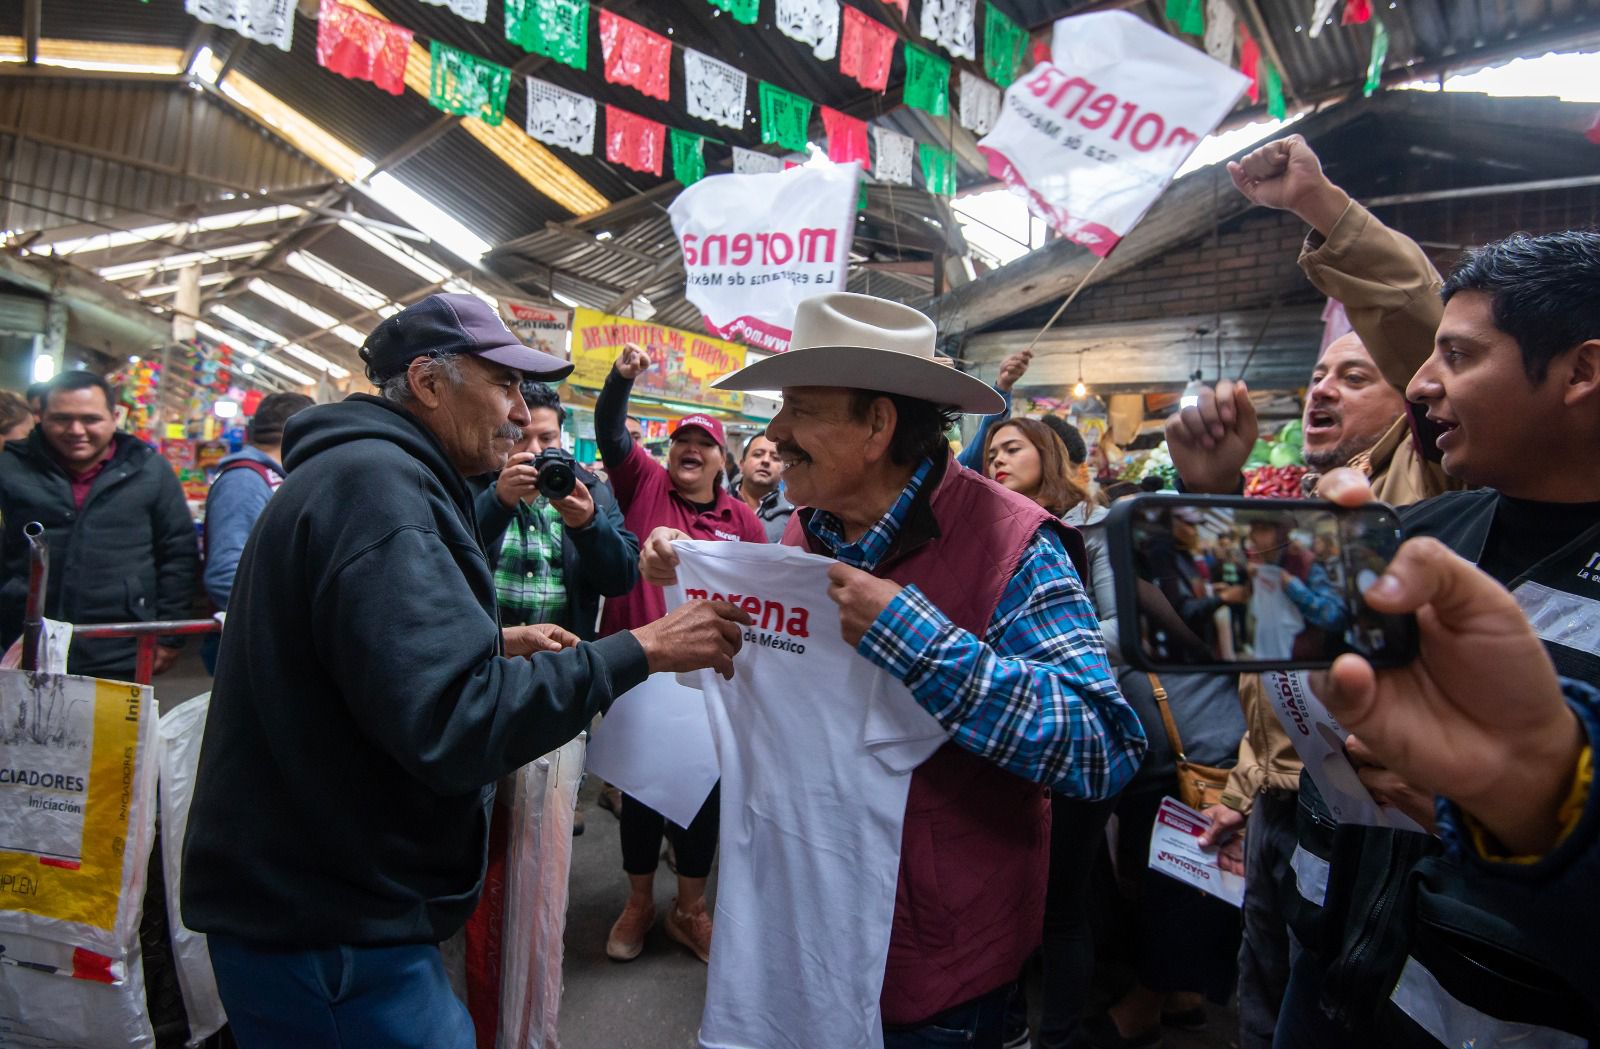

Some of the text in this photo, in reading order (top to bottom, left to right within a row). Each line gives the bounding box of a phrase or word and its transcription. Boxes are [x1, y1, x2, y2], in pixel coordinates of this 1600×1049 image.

[685, 588, 809, 638] ena
[743, 628, 806, 655] de México
[119, 747, 134, 822] INICIADORES
[28, 795, 82, 815] Iniciación
